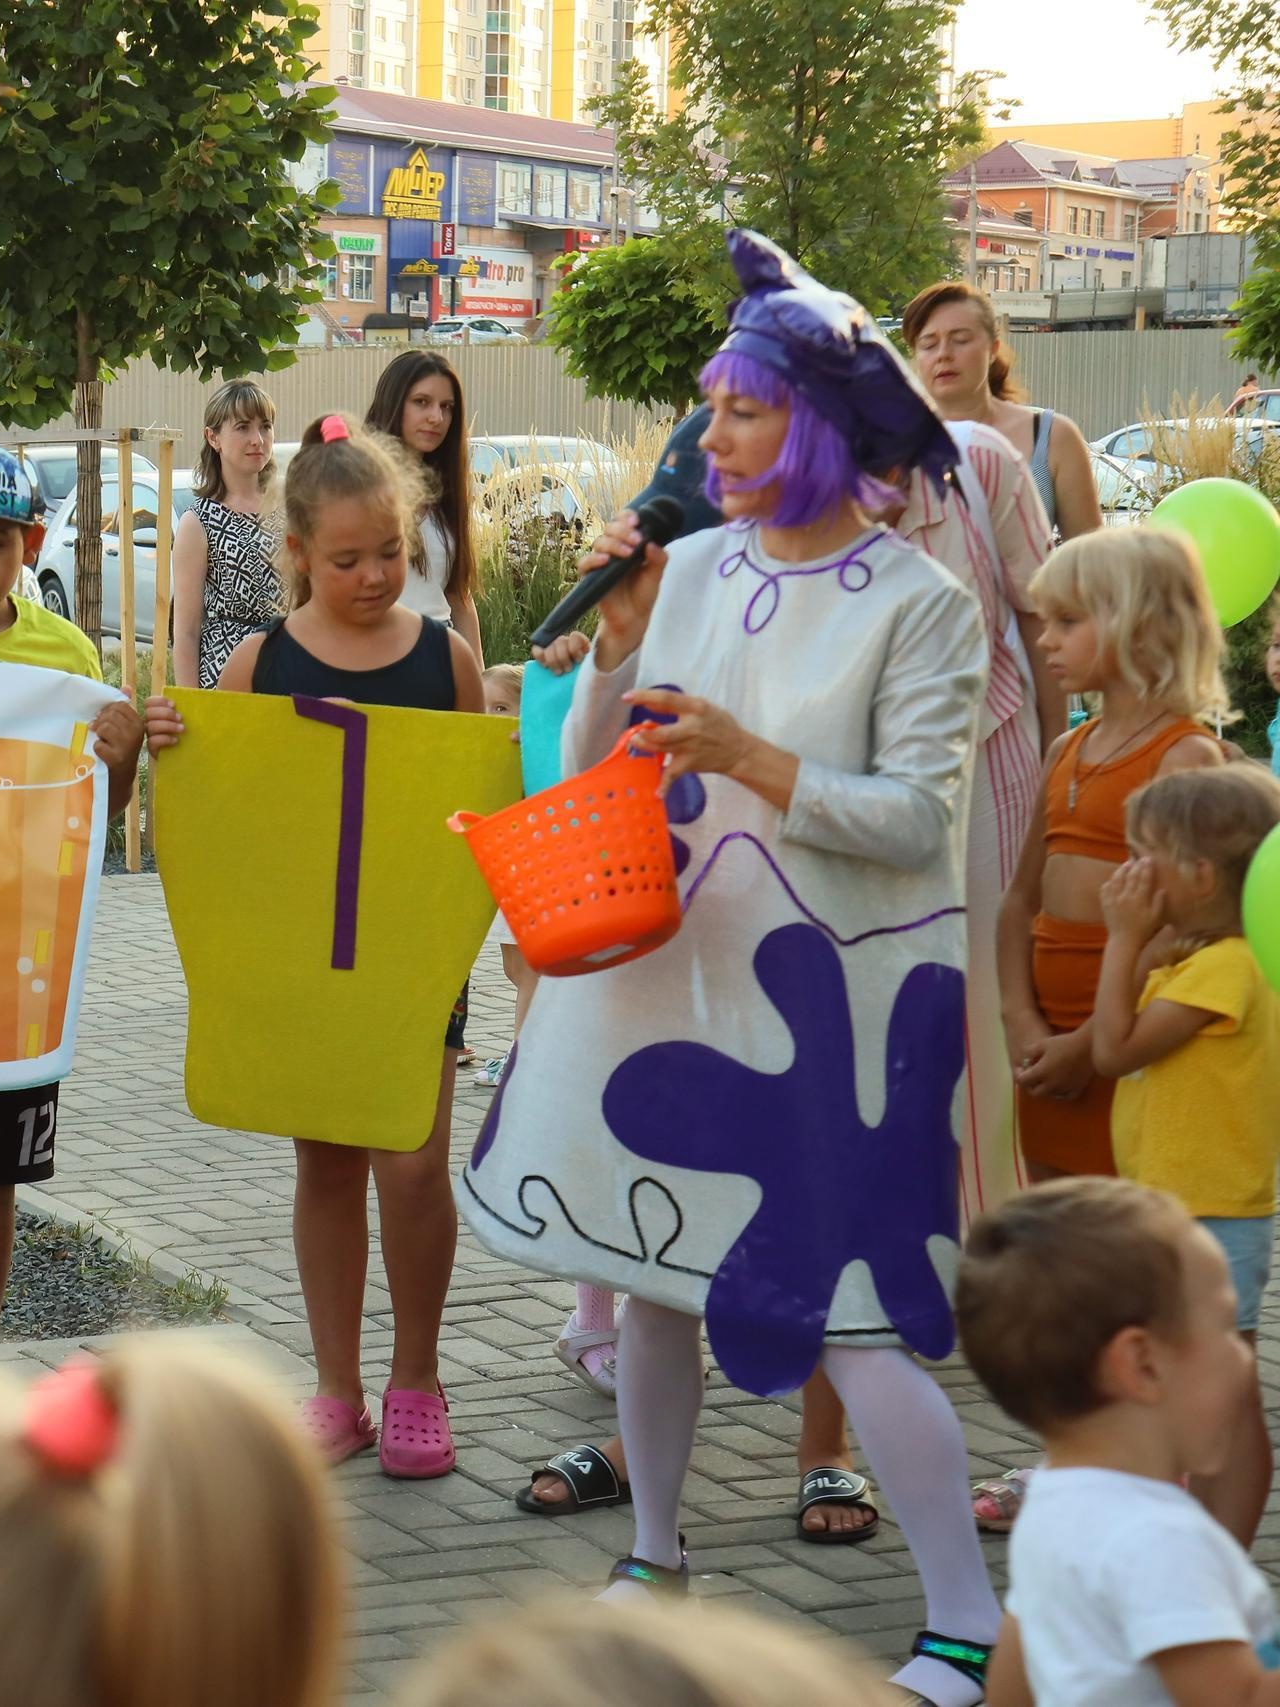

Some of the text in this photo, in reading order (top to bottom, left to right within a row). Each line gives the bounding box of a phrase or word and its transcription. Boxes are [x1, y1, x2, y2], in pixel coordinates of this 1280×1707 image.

[384, 148, 445, 199] ЛИДЕР
[443, 226, 453, 253] Torex
[17, 1100, 56, 1167] 12
[553, 1450, 593, 1476] FILA
[803, 1476, 855, 1494] FILA
